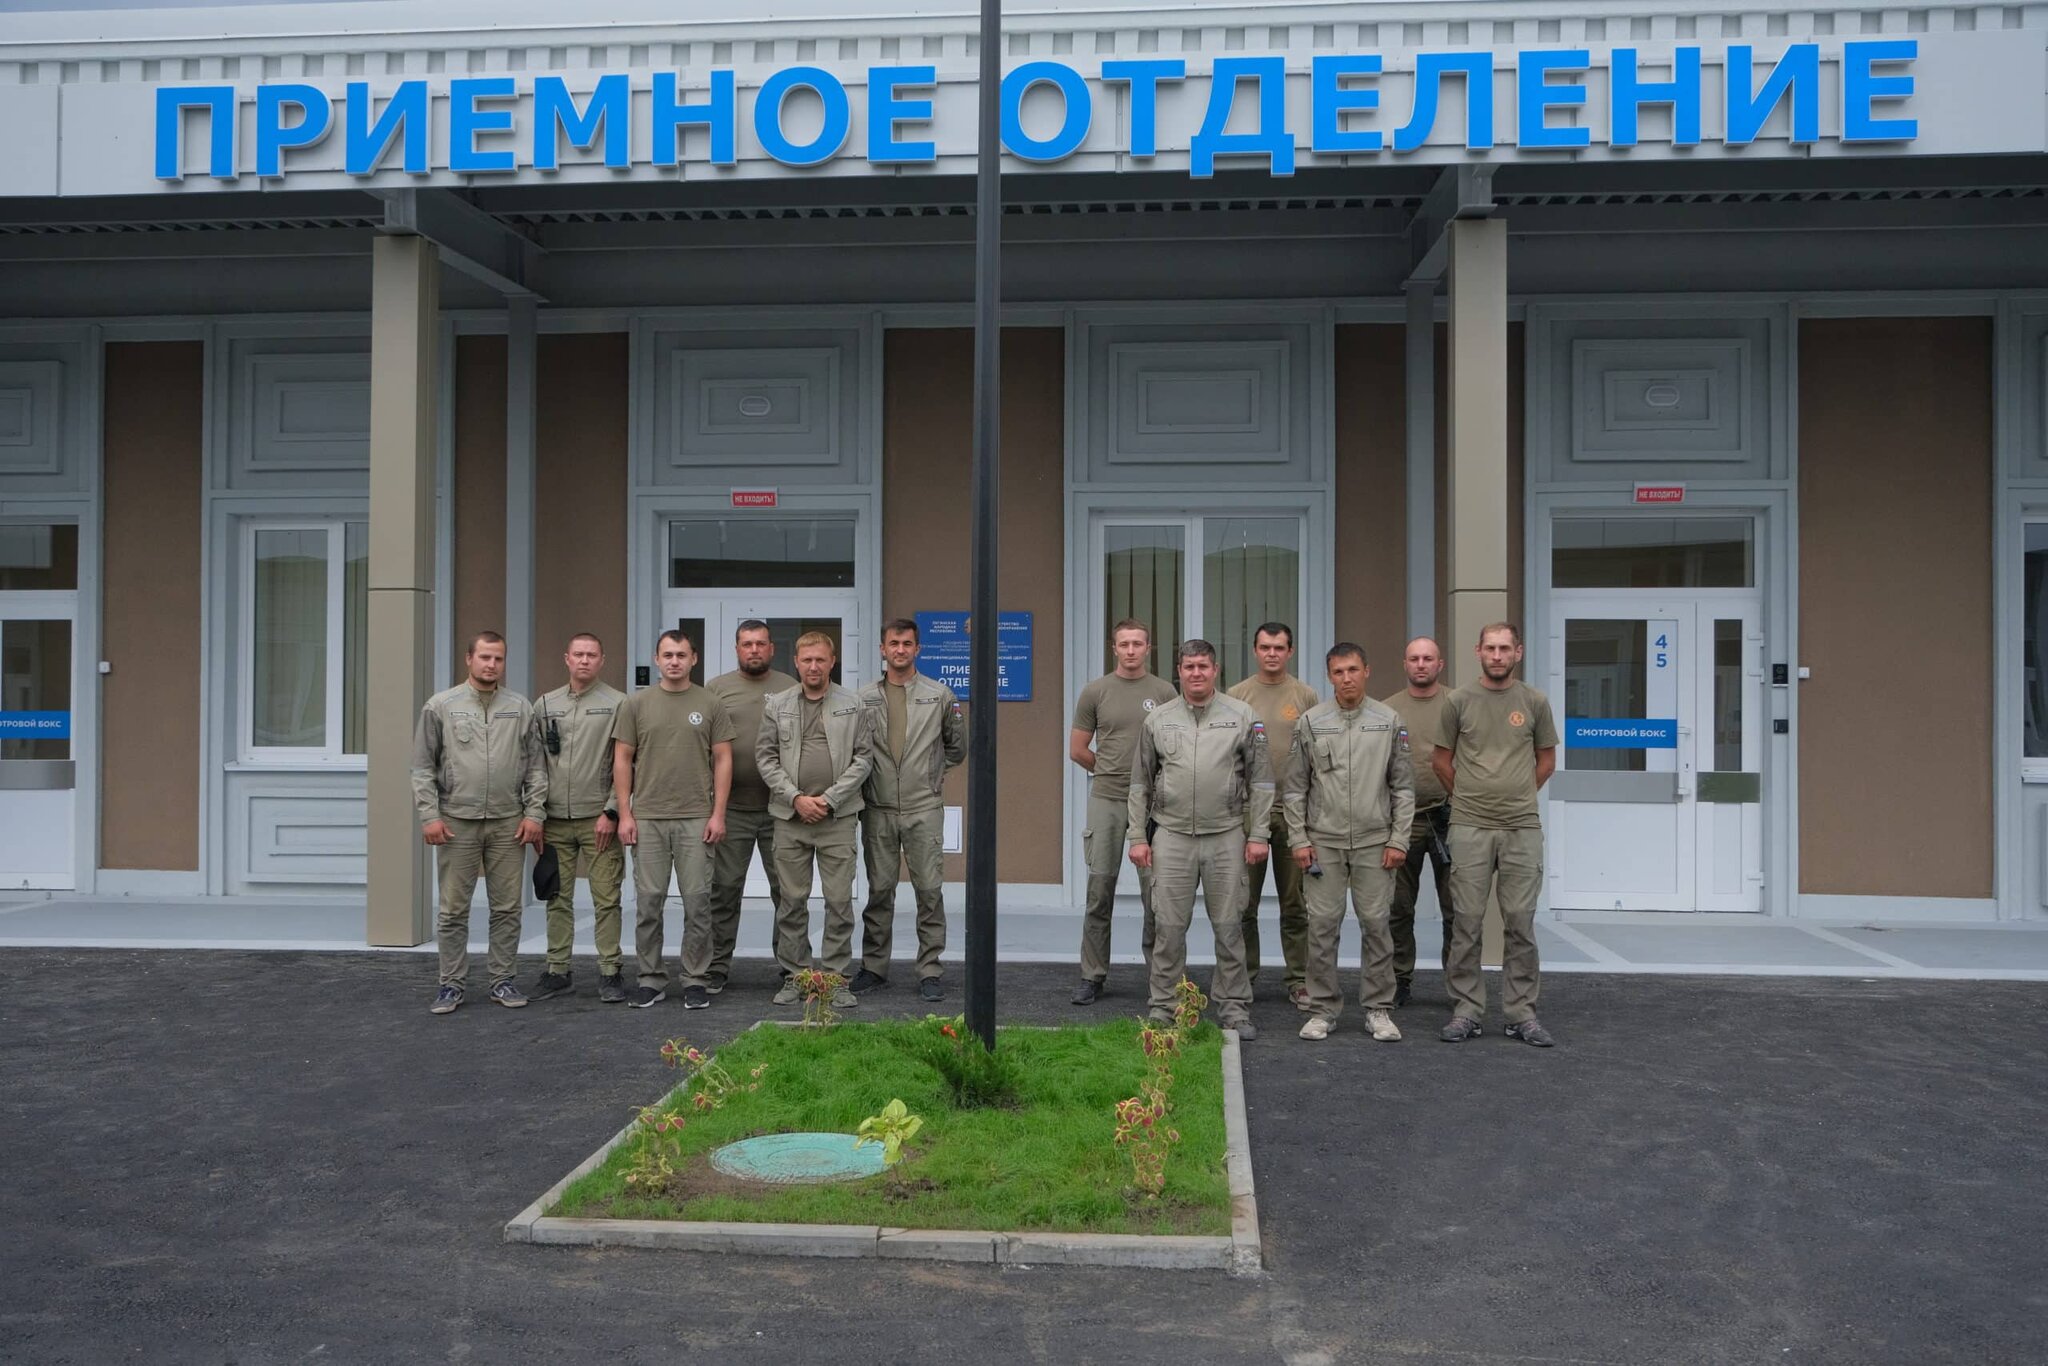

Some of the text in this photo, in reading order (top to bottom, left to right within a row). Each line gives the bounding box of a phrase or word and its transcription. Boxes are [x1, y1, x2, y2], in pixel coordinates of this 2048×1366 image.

[155, 40, 1919, 180] ПРИЕМНОЕ ОТДЕЛЕНИЕ
[734, 495, 743, 503] НЕ
[1638, 490, 1648, 498] НЕ
[1654, 634, 1668, 649] 4
[1656, 653, 1668, 668] 5
[941, 665, 1006, 675] ПРИЕЕ
[38, 720, 62, 729] БОКС
[1576, 727, 1667, 738] СМОТРОВОЙ БОКС
